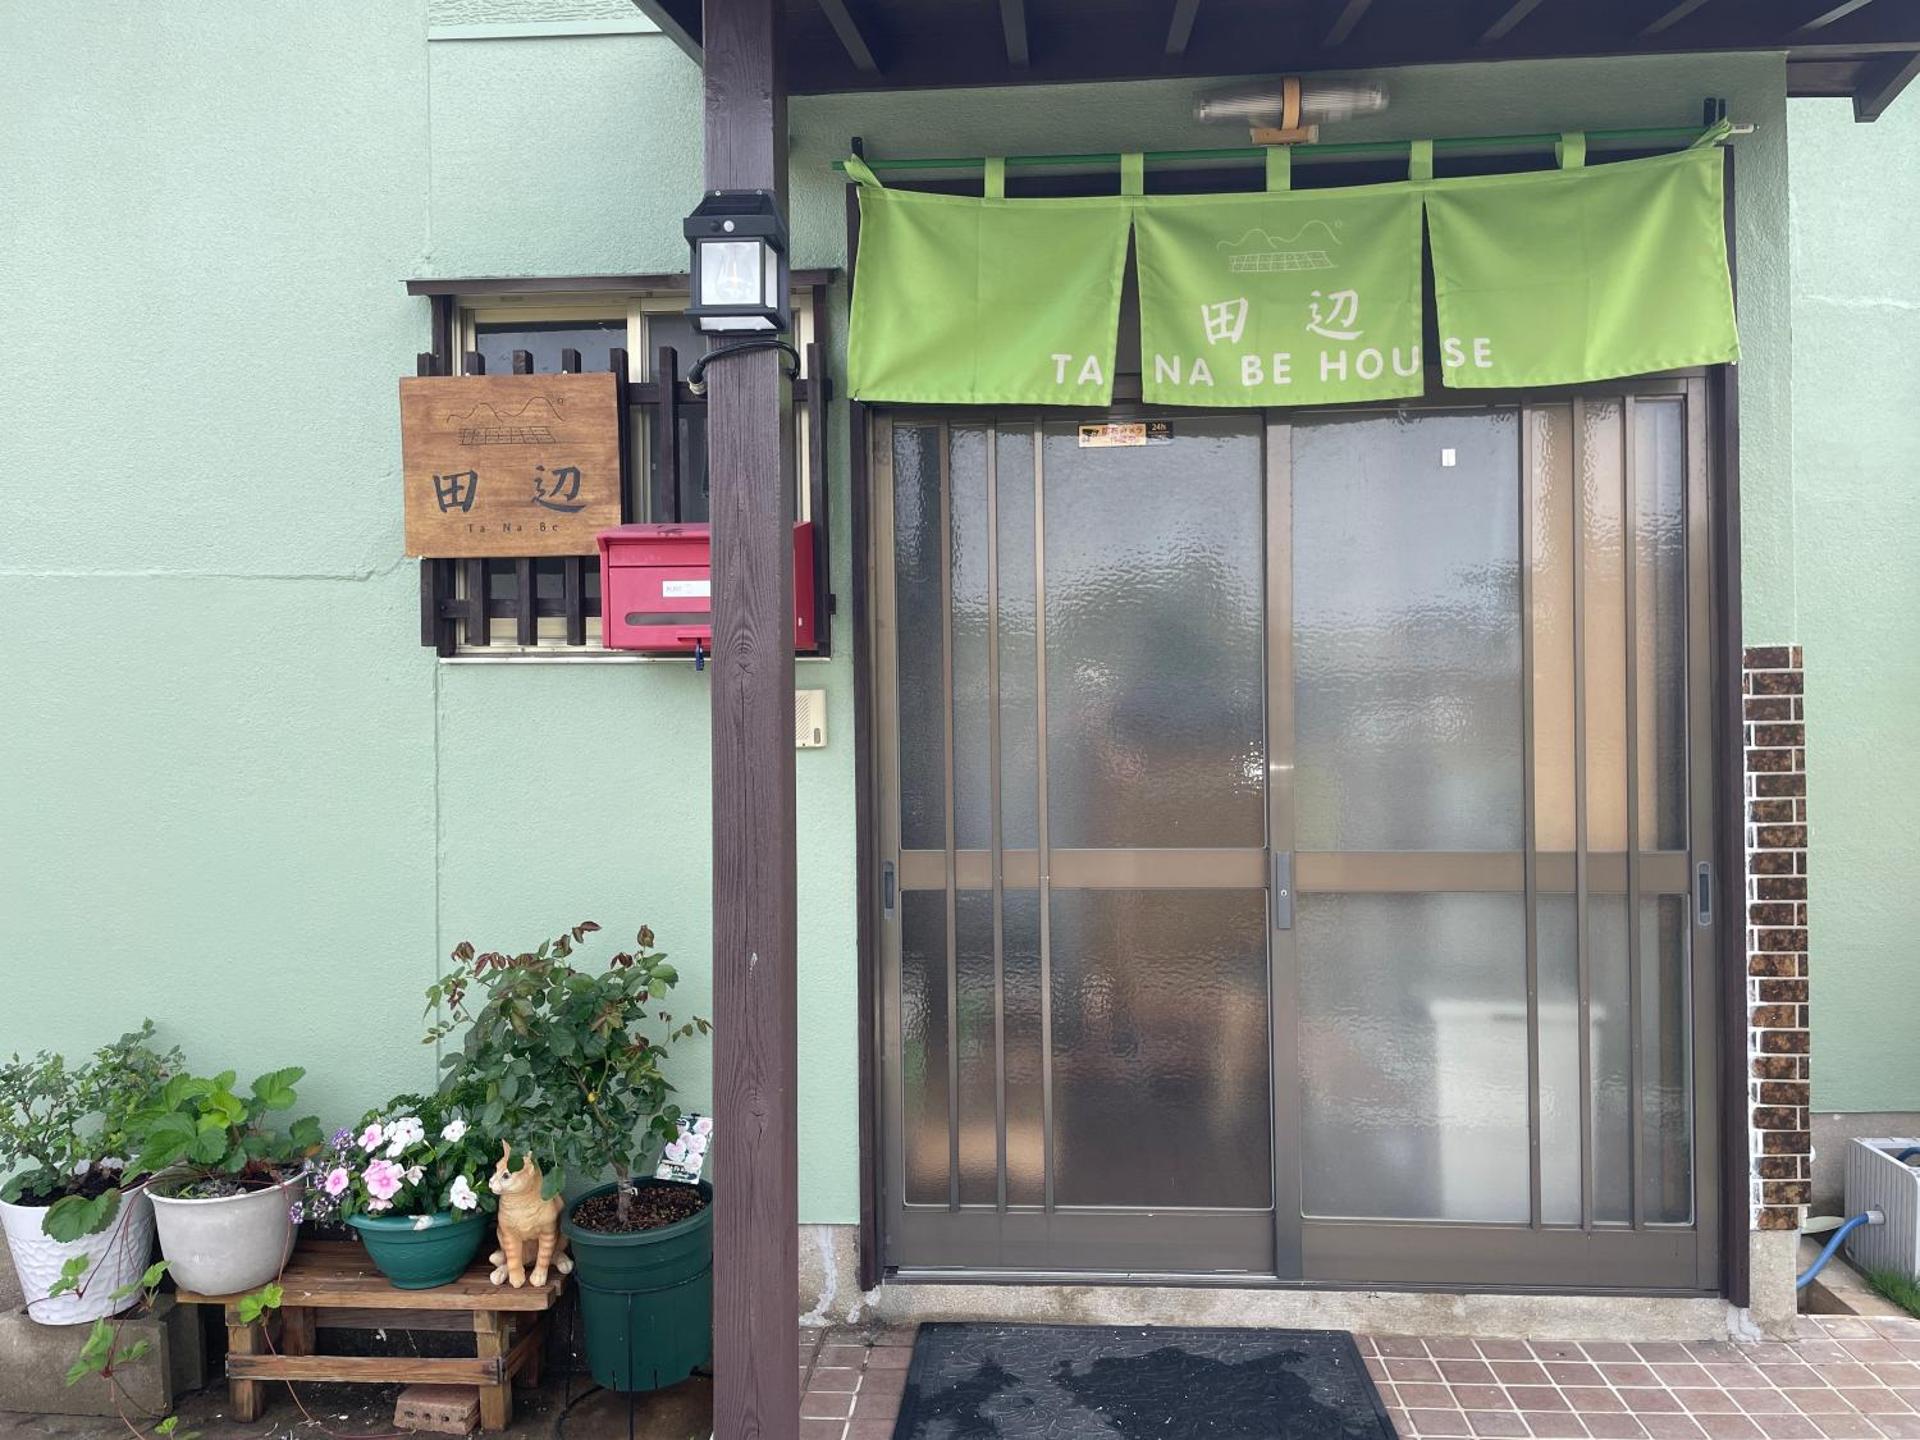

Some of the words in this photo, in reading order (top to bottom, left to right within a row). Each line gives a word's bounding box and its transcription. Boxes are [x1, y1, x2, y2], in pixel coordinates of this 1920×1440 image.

[1201, 288, 1364, 344] 田辺
[1051, 352, 1104, 386] TA
[1153, 353, 1214, 386] NA
[1240, 352, 1292, 386] BE
[1320, 336, 1495, 383] HOUSE
[432, 464, 587, 513] 田辺
